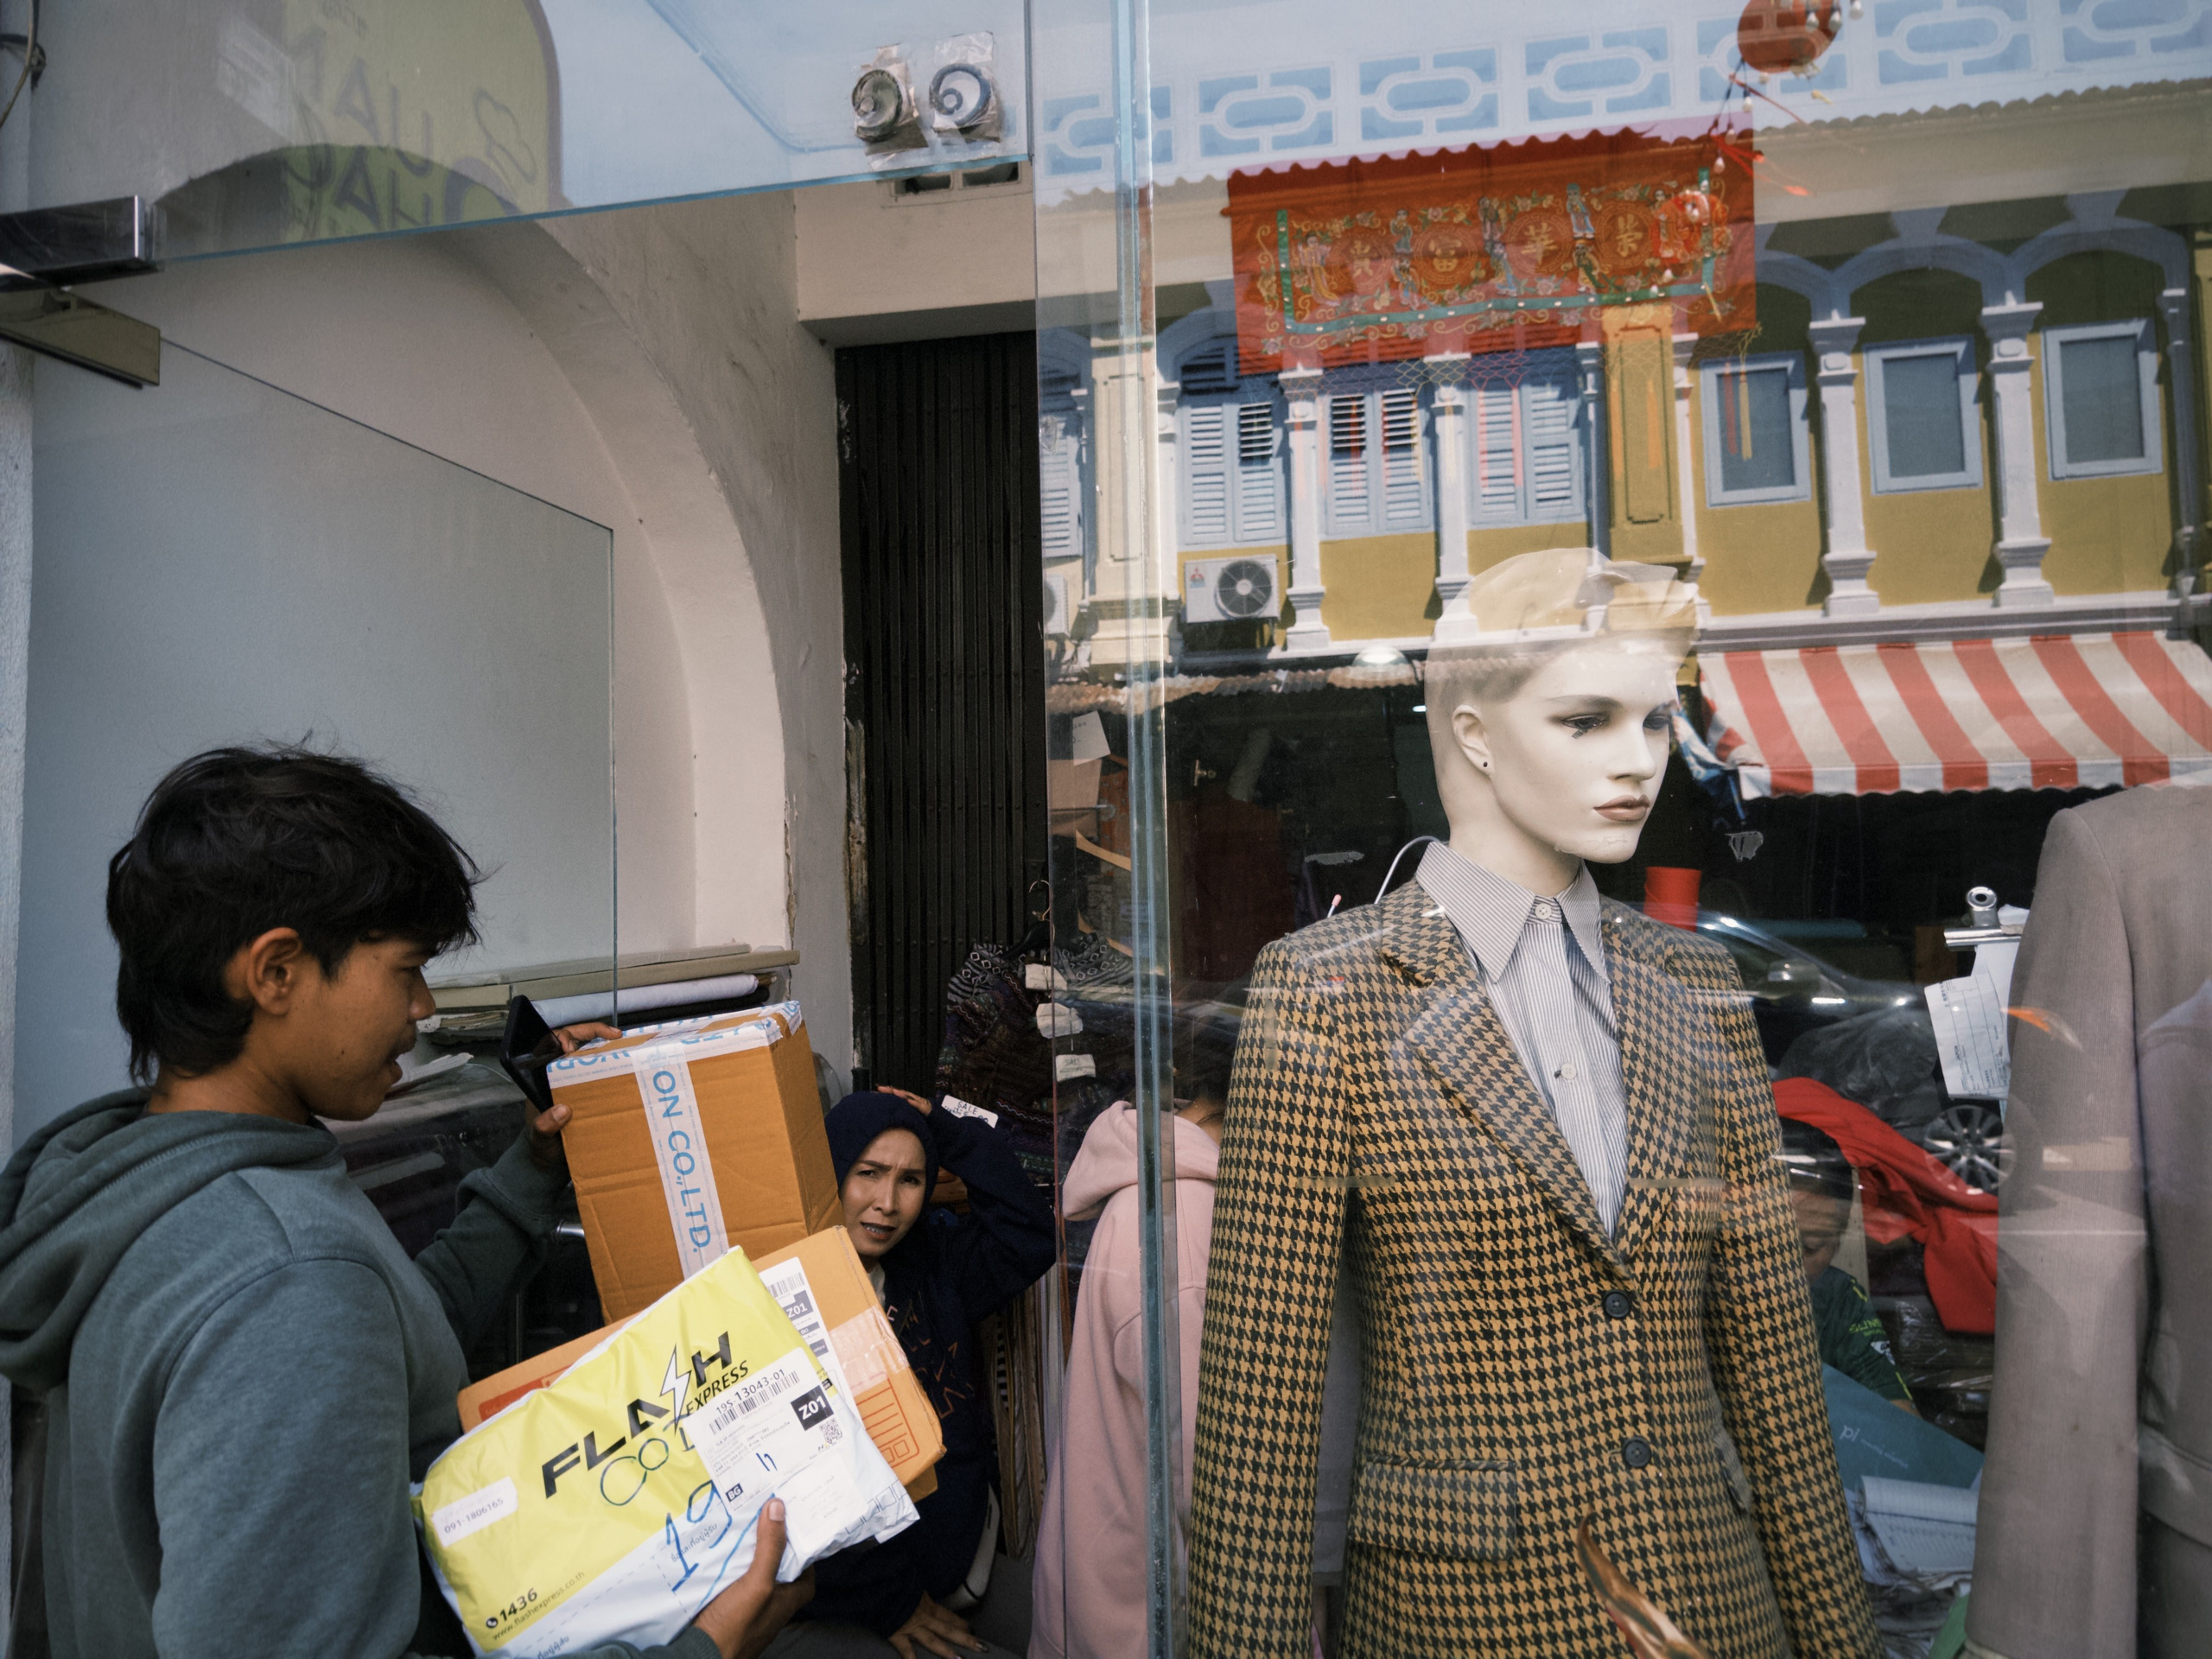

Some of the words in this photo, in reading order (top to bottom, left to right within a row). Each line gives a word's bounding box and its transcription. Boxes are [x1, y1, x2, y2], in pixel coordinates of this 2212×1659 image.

[957, 1101, 978, 1115] SALE
[786, 1302, 809, 1319] Z01
[686, 1360, 749, 1415] EXPRESS
[798, 1395, 827, 1421] Z01
[1840, 1425, 1860, 1442] pi
[728, 1485, 742, 1500] BG
[444, 1497, 504, 1534] 091-1806165
[493, 1571, 586, 1641] www.flashexpress.co.th
[499, 1588, 538, 1621] 1436
